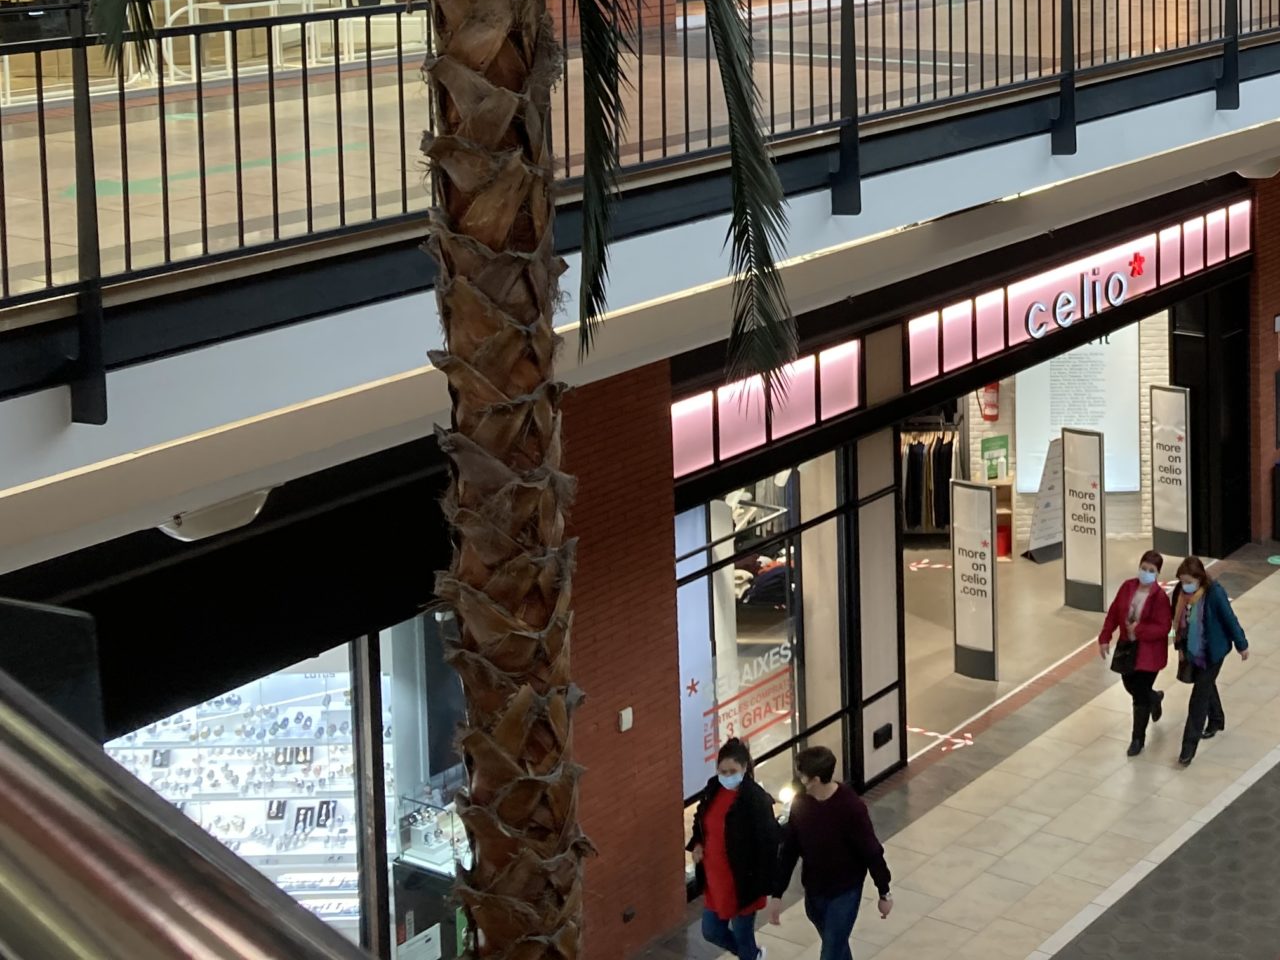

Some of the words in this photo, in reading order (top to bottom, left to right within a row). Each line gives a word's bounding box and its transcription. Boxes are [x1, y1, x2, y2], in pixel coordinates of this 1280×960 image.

[1025, 268, 1128, 339] celio
[1156, 442, 1181, 453] more
[1167, 455, 1181, 463] on
[1158, 464, 1182, 475] celio
[1068, 488, 1095, 500] more
[1081, 502, 1095, 511] on
[1071, 512, 1096, 524] celio
[958, 546, 986, 560] more
[971, 562, 987, 572] on
[961, 572, 987, 586] celio
[741, 689, 793, 730] GRATIS
